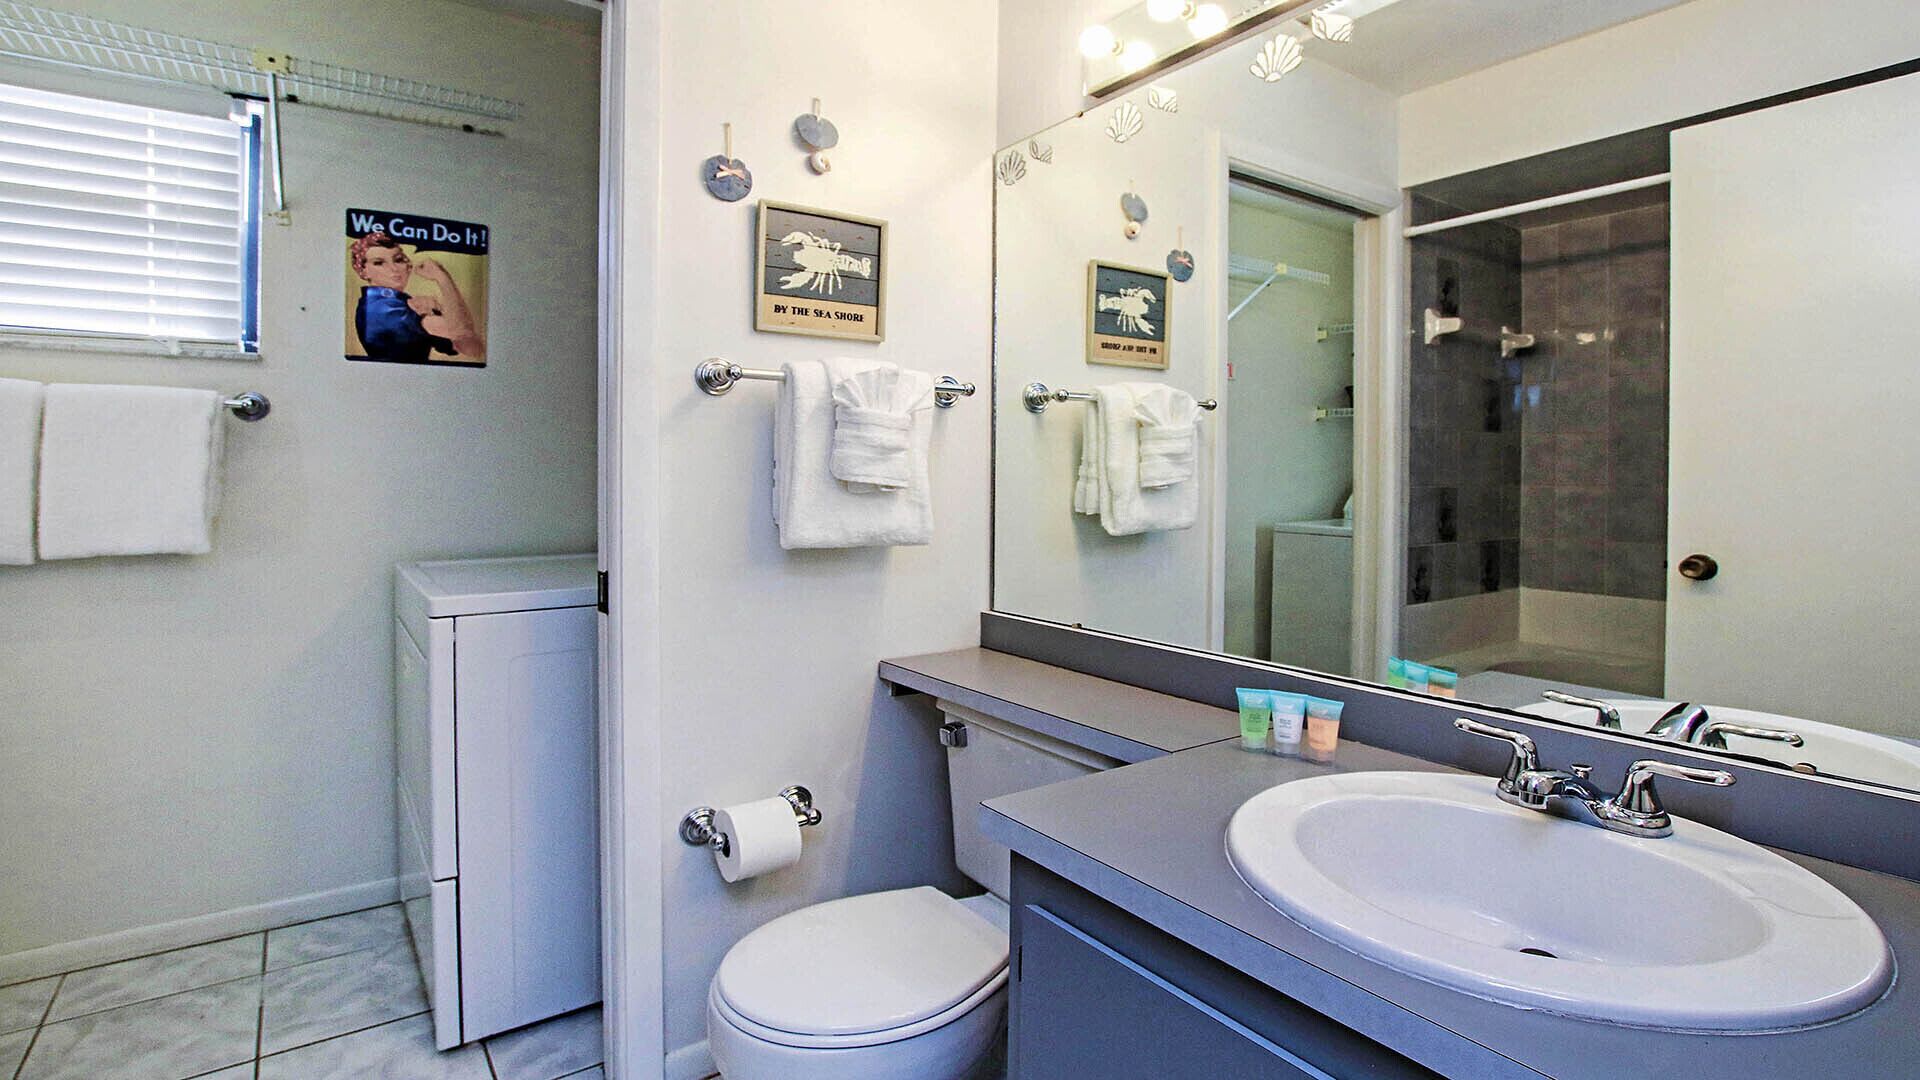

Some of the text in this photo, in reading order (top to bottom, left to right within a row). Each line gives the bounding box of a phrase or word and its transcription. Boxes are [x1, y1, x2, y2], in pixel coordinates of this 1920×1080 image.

[351, 213, 385, 234] We
[389, 218, 428, 240] Can
[433, 223, 461, 243] Do
[773, 304, 865, 323] BY THE SEA SHORE
